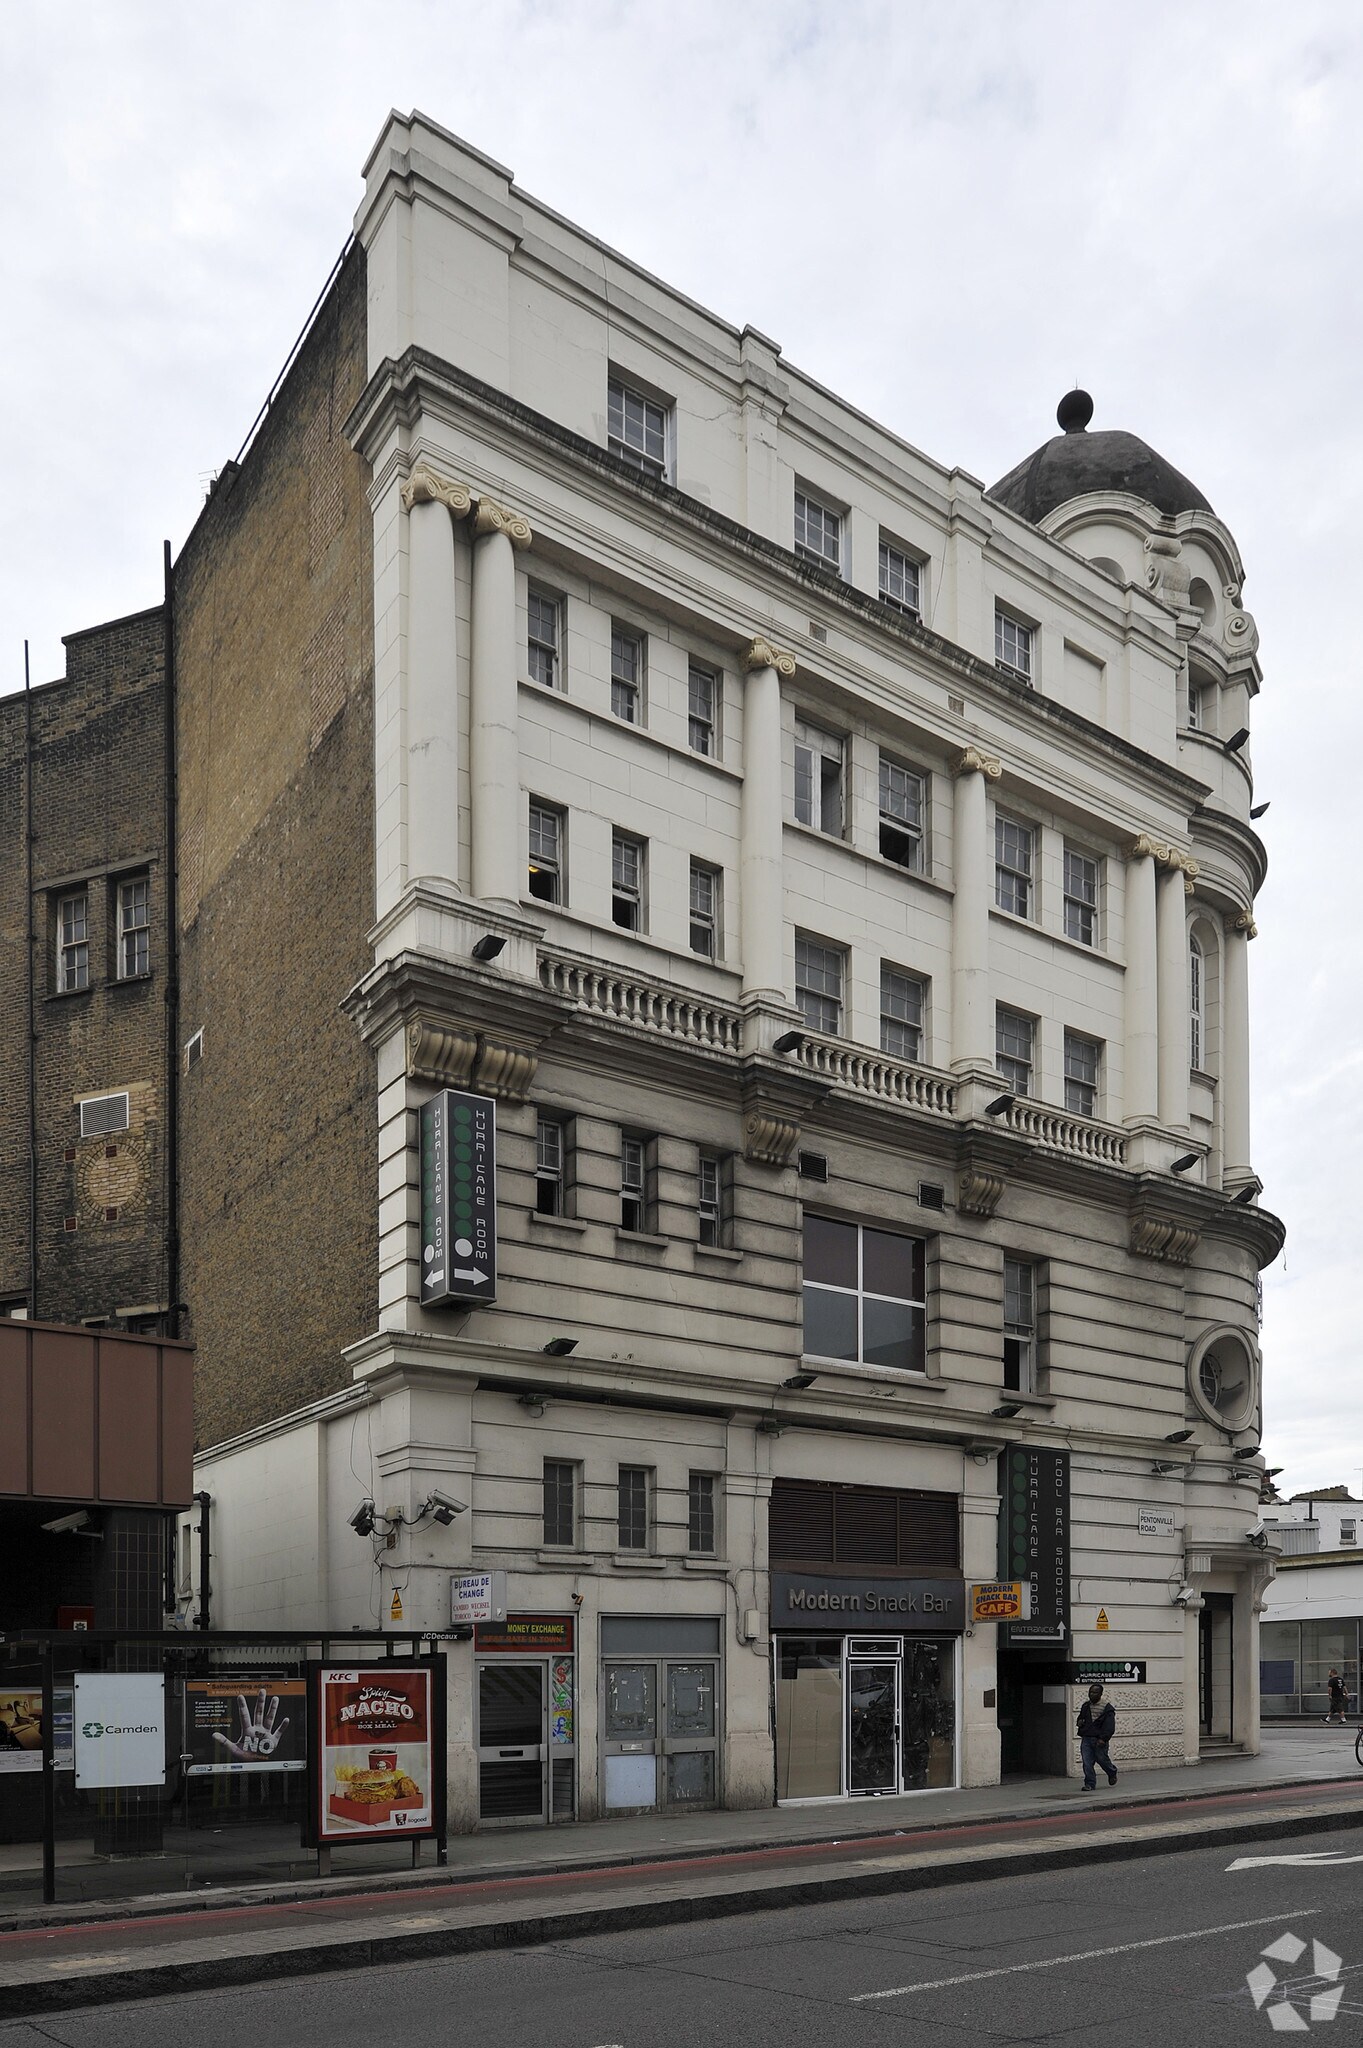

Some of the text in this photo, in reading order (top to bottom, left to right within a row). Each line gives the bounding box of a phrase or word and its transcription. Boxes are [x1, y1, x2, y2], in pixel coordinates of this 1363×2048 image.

[475, 1110, 487, 1260] HURRICANE ROOM
[434, 1216, 442, 1258] ROOM
[1141, 1516, 1173, 1525] PENTONVILLE
[1030, 1455, 1039, 1615] HURRICANE ROOM
[1055, 1458, 1063, 1616] POOL BAR SNOOKER
[454, 1578, 489, 1589] BUREAU DE
[981, 1585, 1013, 1594] MODERN
[459, 1589, 485, 1599] CHANGE
[976, 1593, 1018, 1605] SNACK BAR
[789, 1589, 952, 1612] Modern Snack Bar
[980, 1603, 1012, 1613] CAFE
[507, 1624, 565, 1633] MONEY EXCHANGE
[329, 1673, 352, 1681] KFC
[359, 1687, 406, 1701] Spicy
[340, 1701, 414, 1721] NACHO
[105, 1725, 158, 1735] Camden
[243, 1736, 274, 1754] NO
